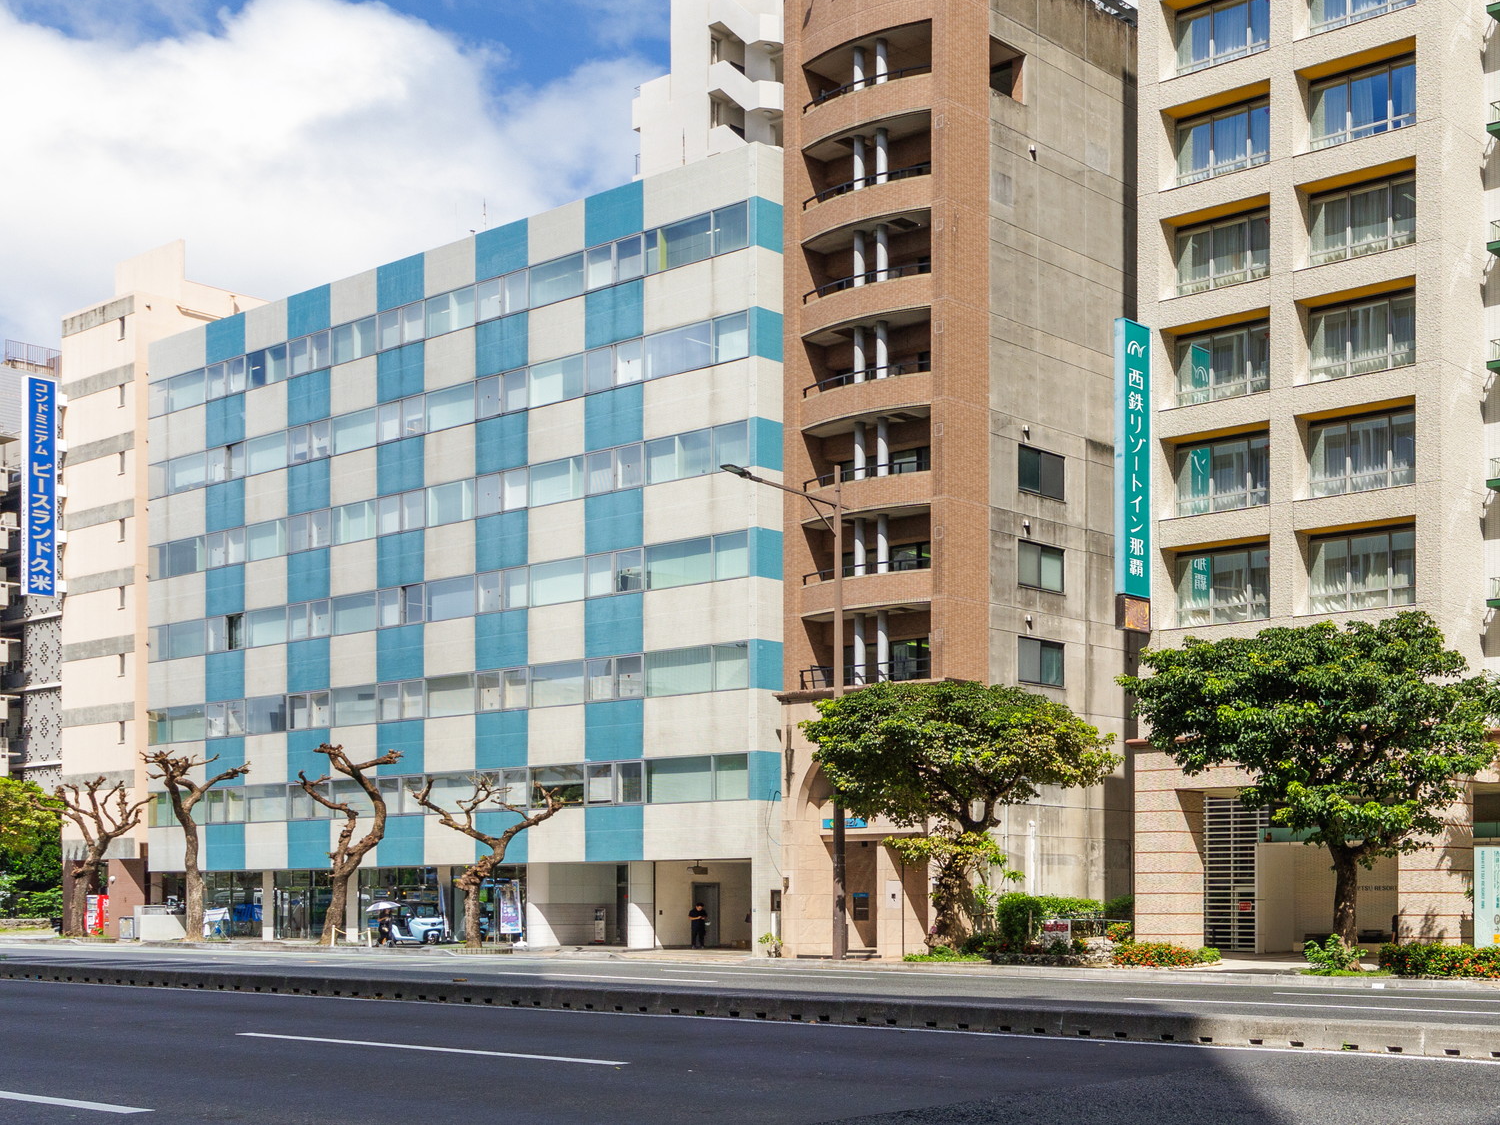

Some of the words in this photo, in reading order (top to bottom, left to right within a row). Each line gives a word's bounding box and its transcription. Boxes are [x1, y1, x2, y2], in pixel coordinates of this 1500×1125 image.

[34, 382, 49, 456] コンドミニアム
[1128, 367, 1146, 578] 西鉄リゾートイン那覇
[30, 461, 52, 591] ピースランド久米
